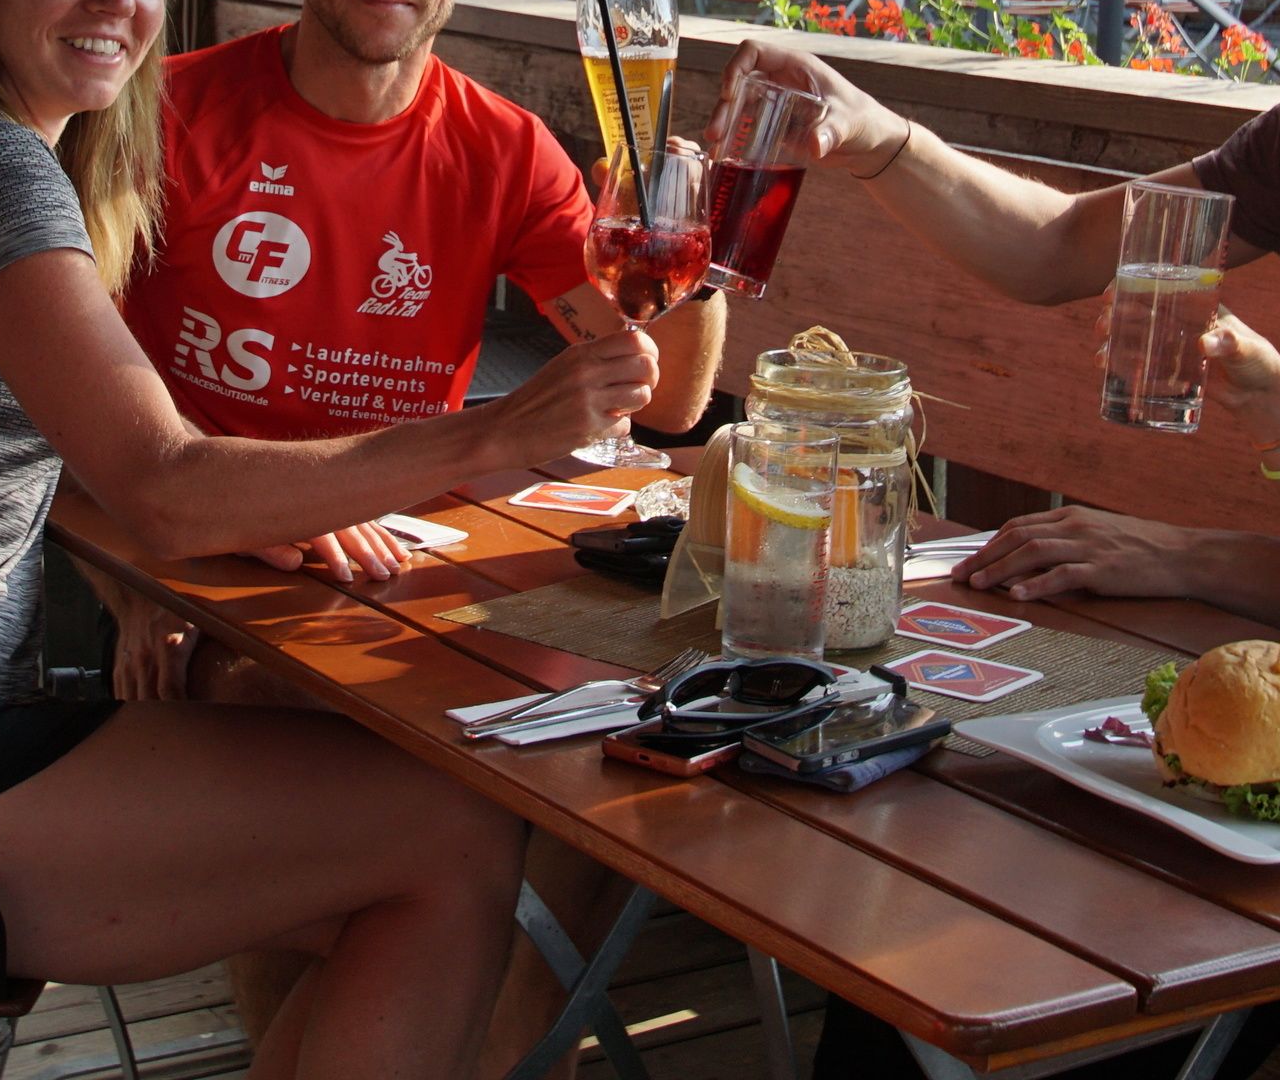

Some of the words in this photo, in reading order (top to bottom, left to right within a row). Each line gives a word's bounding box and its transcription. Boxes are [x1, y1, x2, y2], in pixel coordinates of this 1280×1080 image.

[249, 181, 294, 197] erima
[397, 287, 432, 300] Team
[174, 306, 275, 391] RS
[305, 342, 456, 375] Laufzeitnahme
[169, 366, 269, 406] www.RACESOLUTION.de
[302, 363, 426, 393] Sportevents
[300, 385, 370, 407] Verkauf
[372, 395, 385, 410] &
[391, 398, 449, 415] Verleih
[328, 407, 350, 418] von
